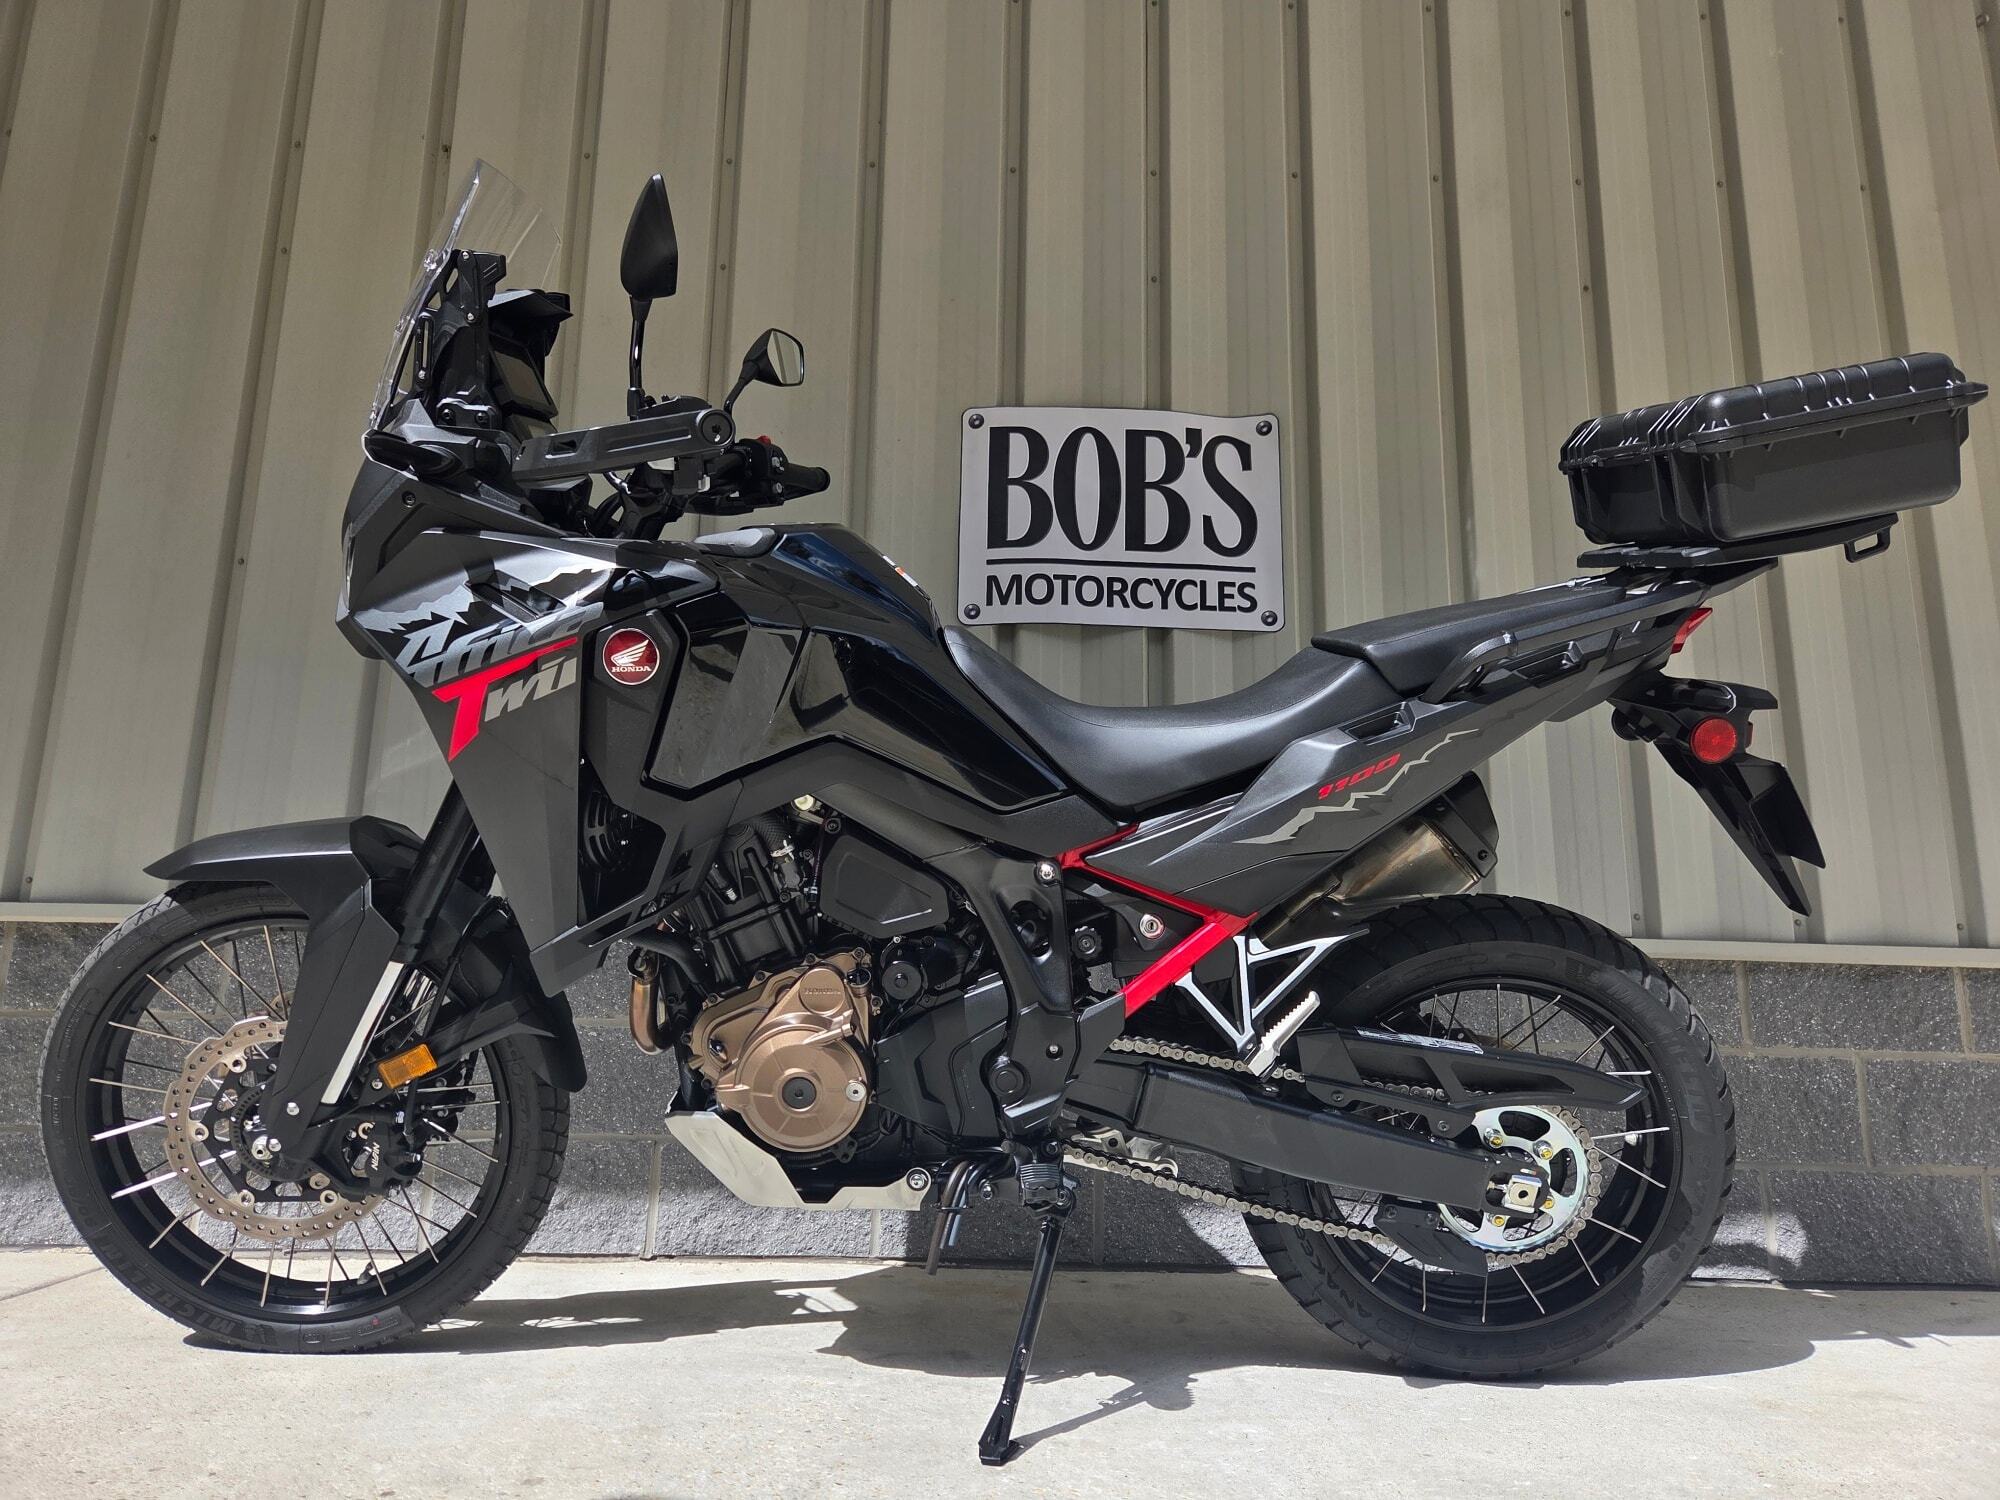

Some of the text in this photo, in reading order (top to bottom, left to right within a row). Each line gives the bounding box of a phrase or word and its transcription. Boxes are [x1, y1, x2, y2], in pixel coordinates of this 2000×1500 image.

[986, 425, 1258, 558] BOB'S
[985, 572, 1258, 614] MOTORCYCLES
[1318, 752, 1401, 800] 1100
